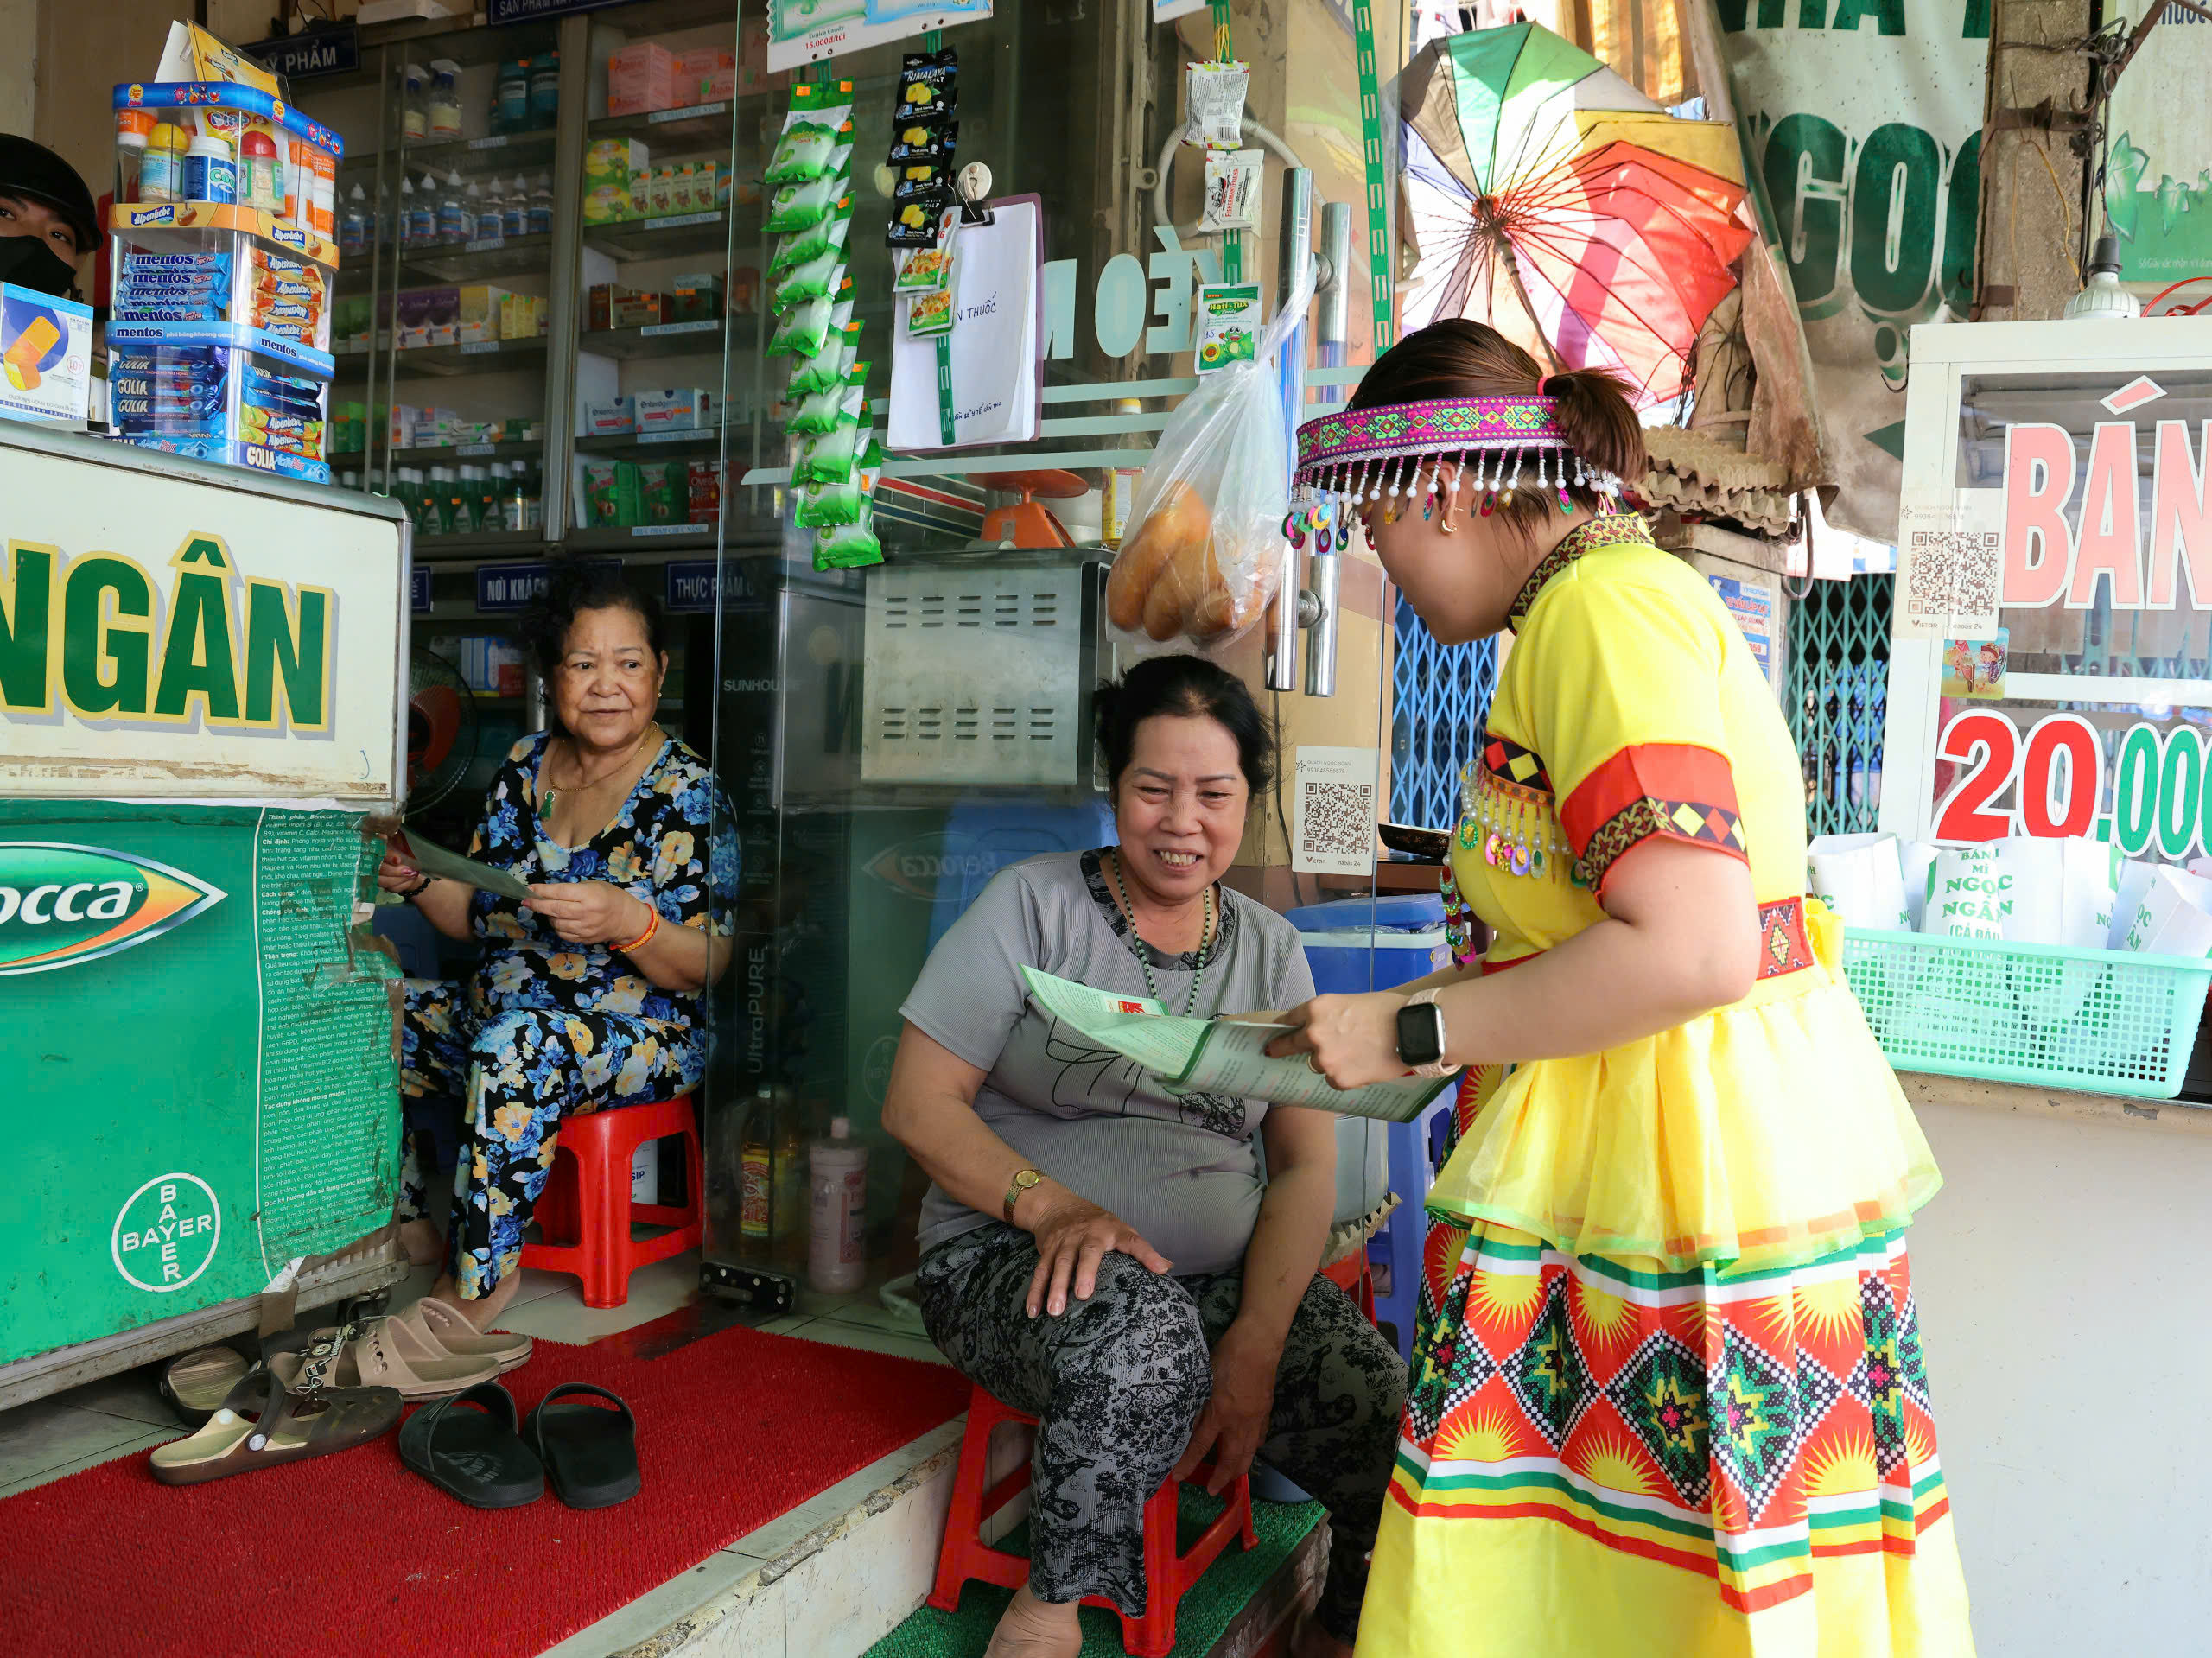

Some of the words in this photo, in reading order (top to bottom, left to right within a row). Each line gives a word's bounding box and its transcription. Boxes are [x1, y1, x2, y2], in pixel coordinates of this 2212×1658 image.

[285, 38, 337, 73] PHẨM
[907, 67, 946, 82] HIMALAYA
[134, 207, 172, 226] Alpenliebe
[274, 226, 303, 241] Alpenliebe
[136, 255, 194, 265] mentos
[133, 273, 192, 283] mentos
[277, 282, 310, 295] Alpenliebe
[966, 290, 997, 320] THUỐC
[124, 308, 182, 321] mentos
[116, 327, 164, 338] mentos
[261, 338, 298, 357] mentos
[117, 379, 149, 395] GOLIA
[117, 399, 149, 413] GOLIA
[269, 416, 302, 430] Alpenliebe
[246, 445, 276, 471] GOLIA
[1999, 375, 2212, 609] BÁN
[1933, 708, 2212, 862] 20.00
[747, 947, 766, 1074] UltraPURE
[122, 1213, 213, 1252] BAYER
[158, 1183, 182, 1282] BAYER
